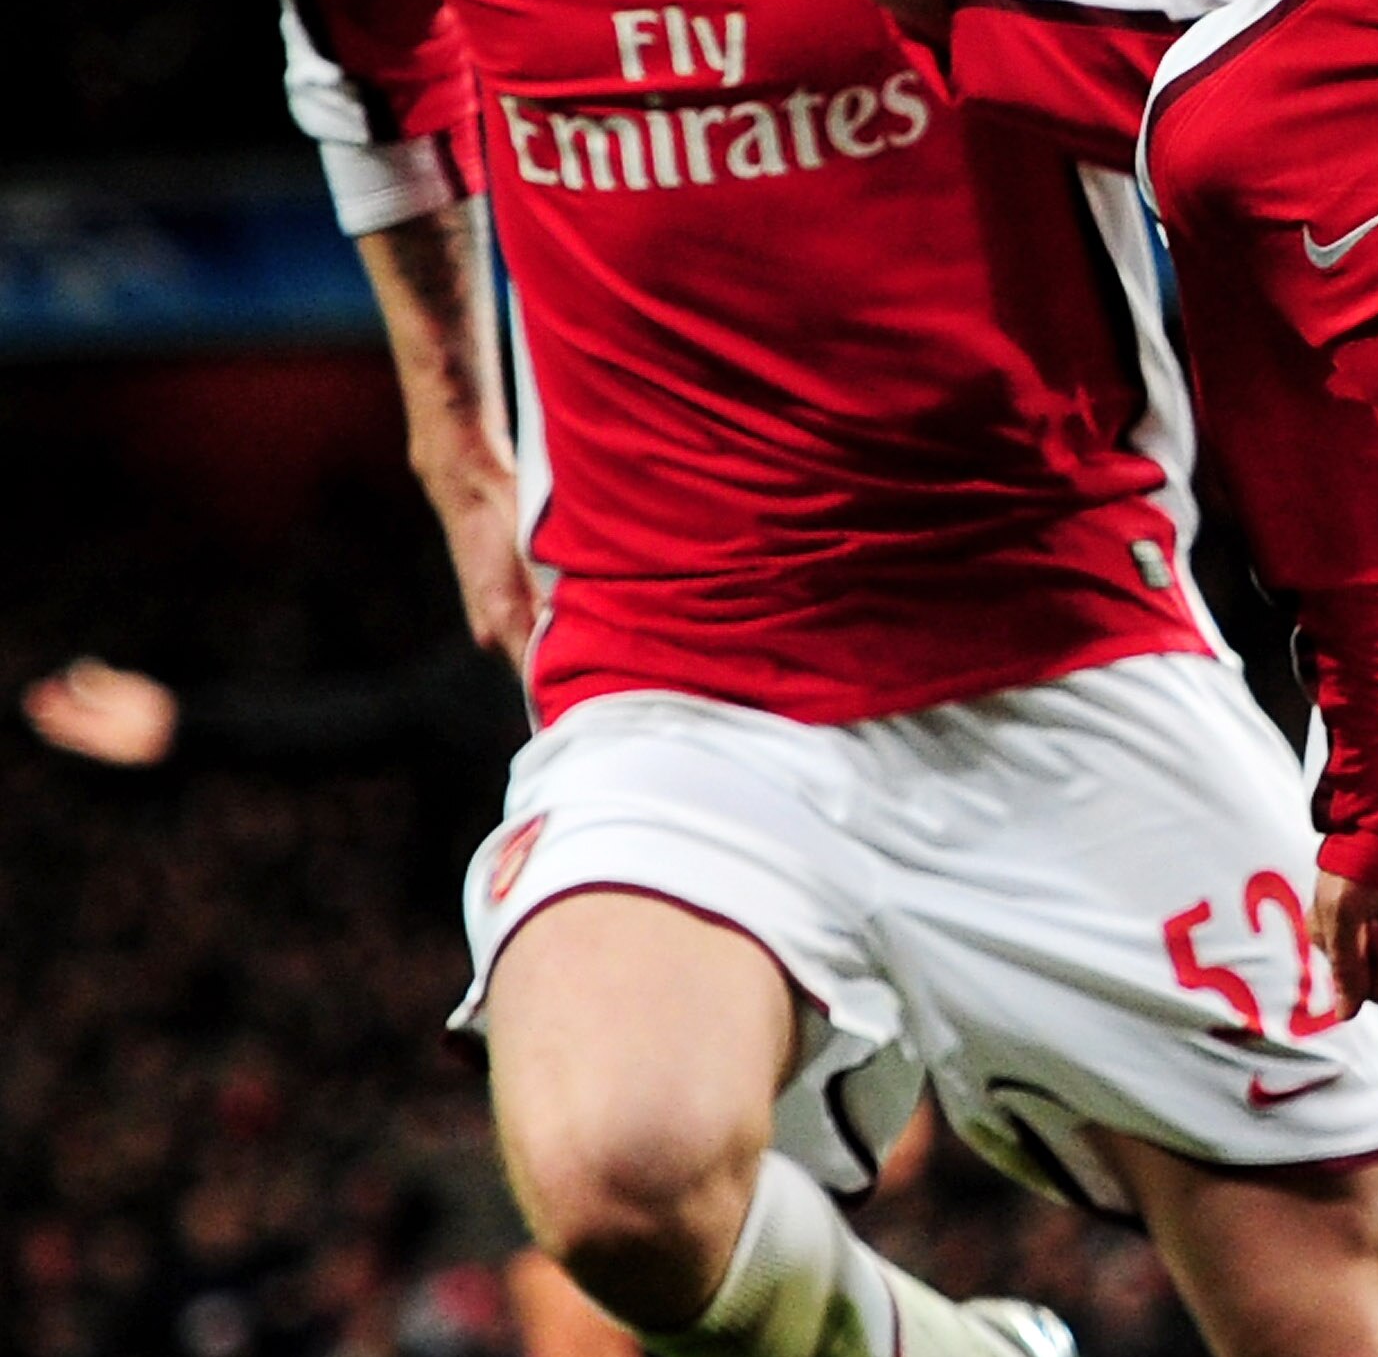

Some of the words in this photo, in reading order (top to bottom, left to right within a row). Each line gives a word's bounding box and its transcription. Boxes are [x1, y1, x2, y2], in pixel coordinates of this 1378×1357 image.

[612, 5, 747, 87] Fly
[500, 69, 930, 192] Emirates
[1164, 870, 1338, 1037] 52
